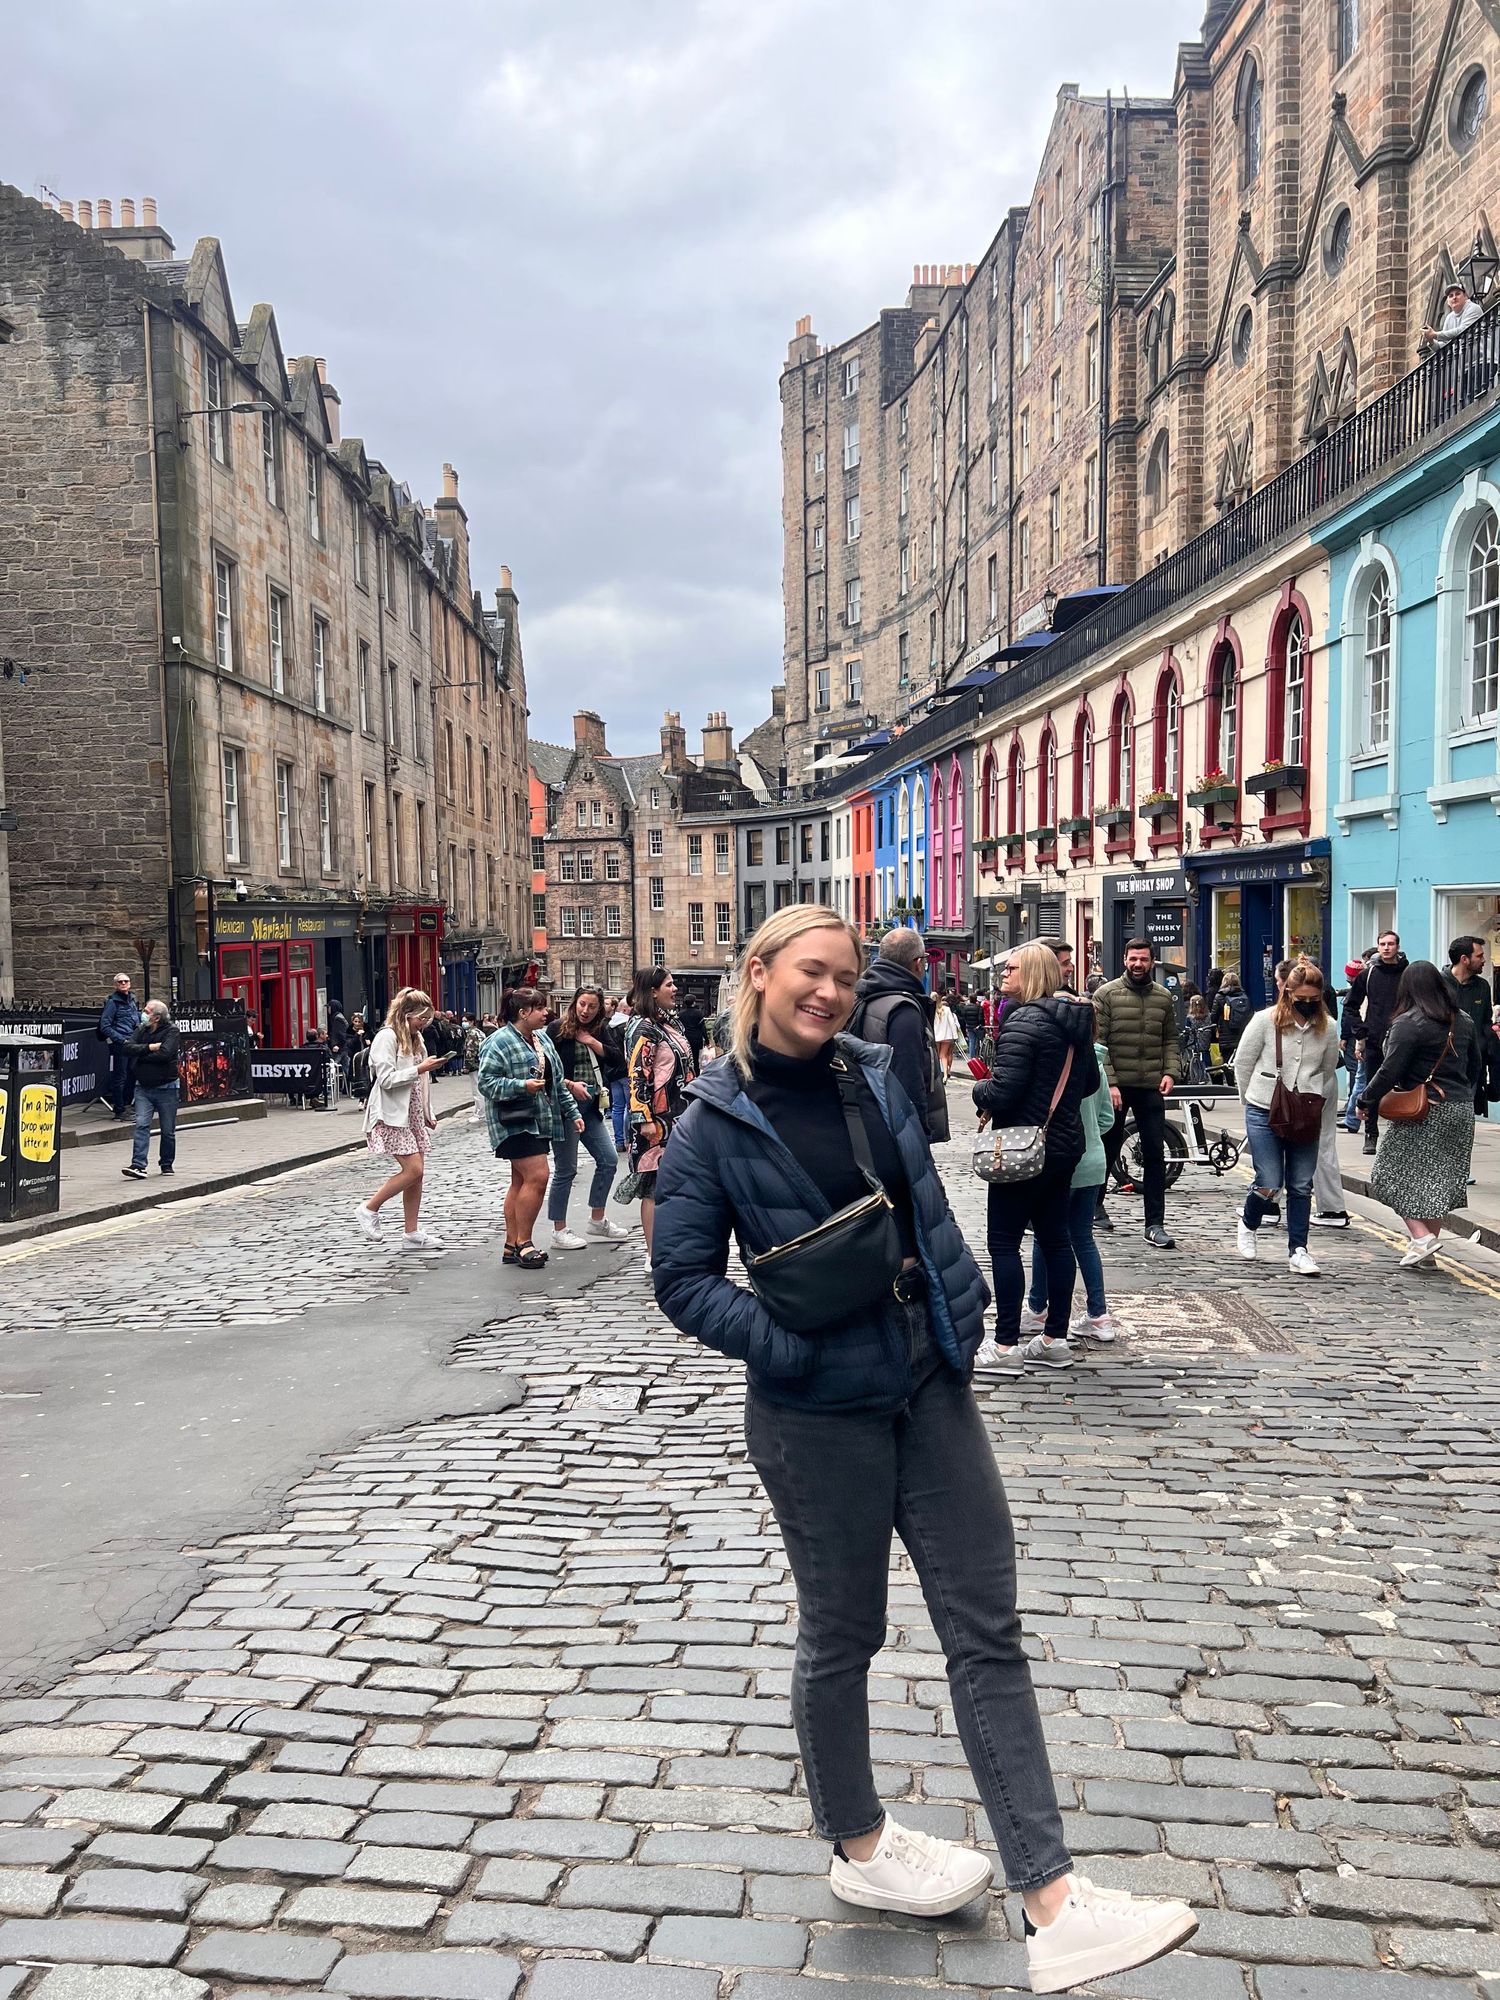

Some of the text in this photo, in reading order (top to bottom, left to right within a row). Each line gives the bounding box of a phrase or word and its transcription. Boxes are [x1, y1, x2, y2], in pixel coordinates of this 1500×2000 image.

[1116, 877, 1175, 893] THE WHISKY SHOP
[215, 917, 245, 934] Mexican
[251, 911, 292, 941] Mariachi
[297, 917, 326, 932] Restaurant
[1147, 924, 1182, 932] WHISKY
[0, 1023, 63, 1036] DAY OF EVERY MONTH
[190, 1019, 214, 1033] GARDEN
[62, 1073, 96, 1097] HE STUDIO
[21, 1094, 33, 1114] I'm
[36, 1101, 42, 1112] a
[44, 1098, 56, 1113] bin
[21, 1121, 54, 1134] Drop your
[23, 1136, 41, 1149] litter
